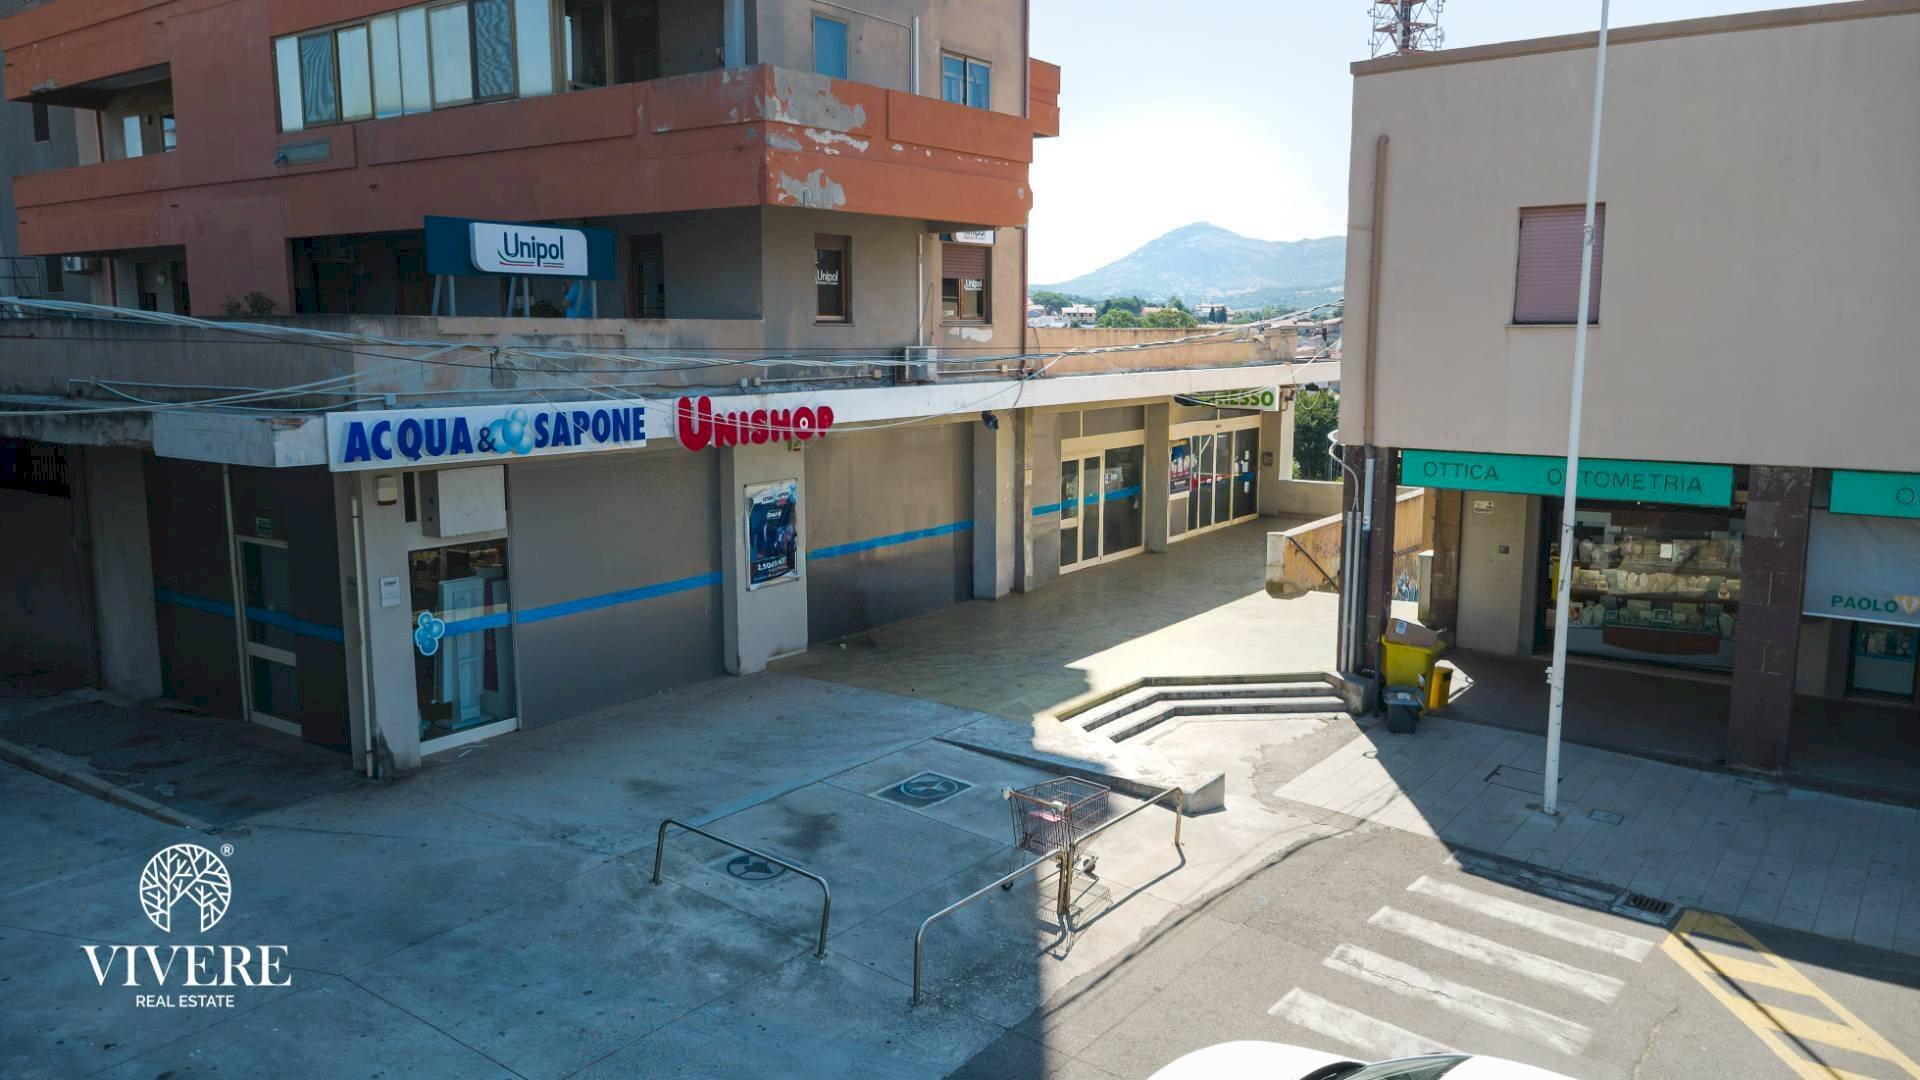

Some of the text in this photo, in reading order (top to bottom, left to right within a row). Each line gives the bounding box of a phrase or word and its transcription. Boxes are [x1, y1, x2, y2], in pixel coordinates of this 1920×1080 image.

[504, 231, 564, 267] Unipol
[817, 269, 839, 284] Unipol
[344, 407, 645, 463] ACQUA & SAPONE
[678, 395, 834, 452] UNISHOP
[1423, 461, 1703, 493] OTTICA OTOMETRIA
[1831, 594, 1899, 614] PAOLO
